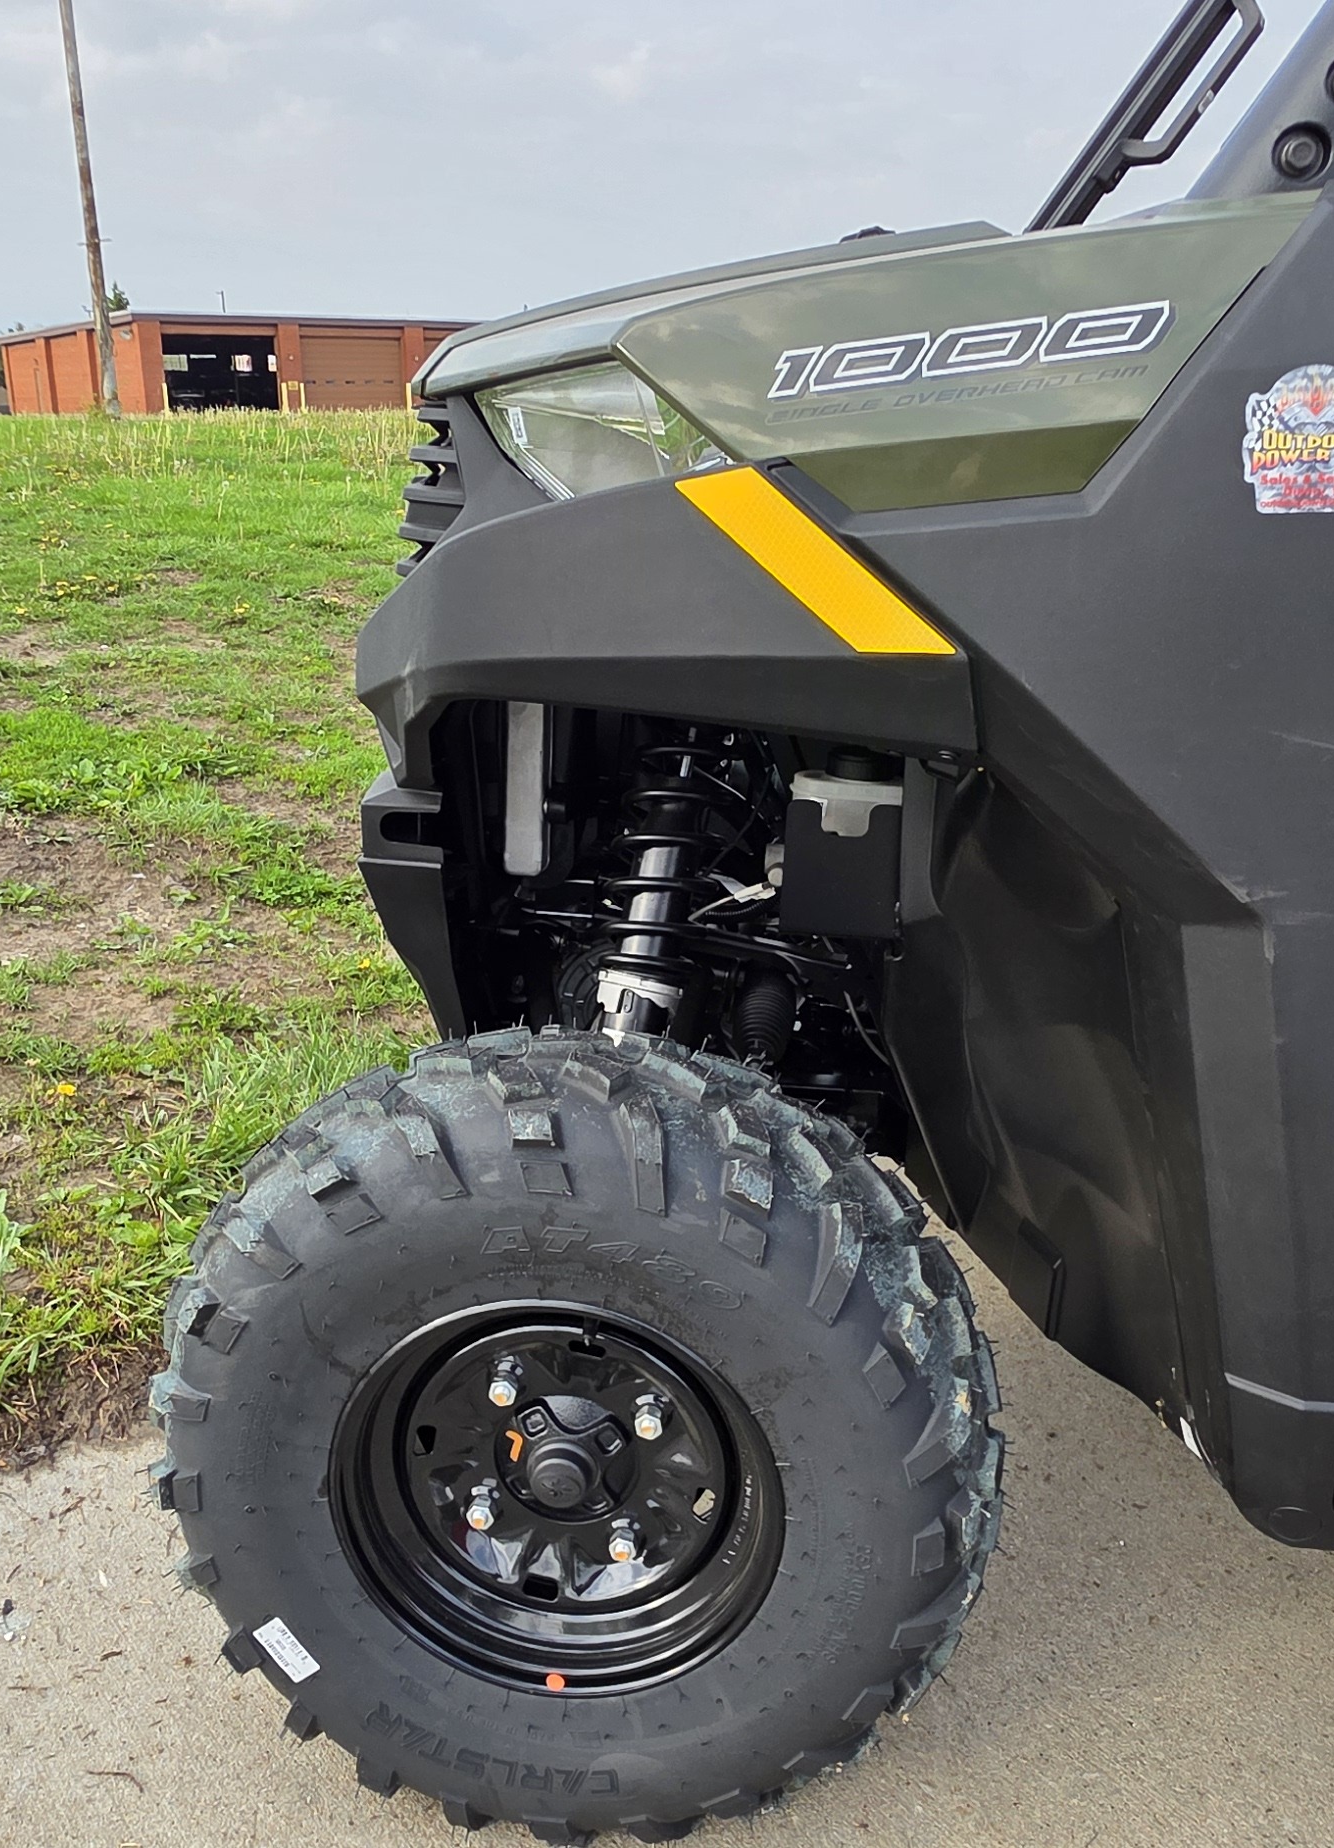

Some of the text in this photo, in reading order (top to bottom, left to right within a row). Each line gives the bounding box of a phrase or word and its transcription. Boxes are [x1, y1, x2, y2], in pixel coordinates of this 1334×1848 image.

[767, 299, 1175, 402] 1000
[767, 363, 1150, 425] SINGLE OVERHEAD CAM
[1251, 447, 1331, 475] POWER
[1260, 472, 1299, 486] Sales
[359, 1699, 621, 1797] CARLSTAR
